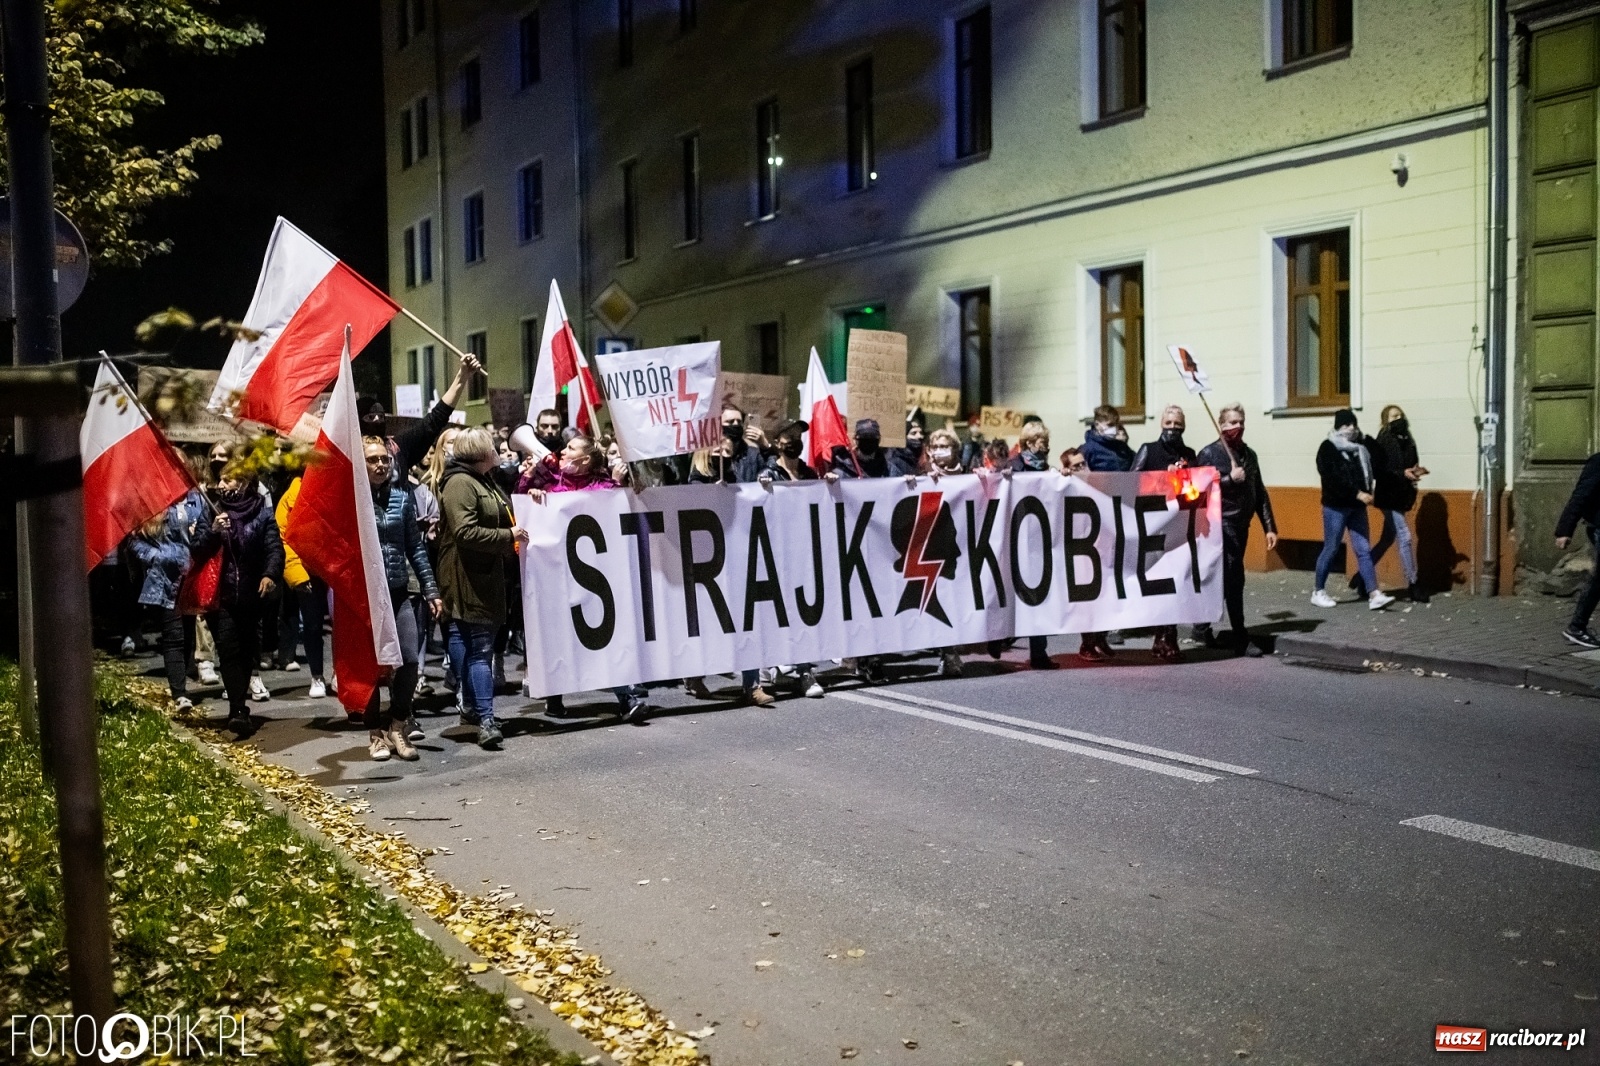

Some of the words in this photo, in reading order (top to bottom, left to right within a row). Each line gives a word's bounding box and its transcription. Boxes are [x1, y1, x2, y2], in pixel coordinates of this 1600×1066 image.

[600, 362, 674, 401] WYBÓR
[647, 396, 678, 426] NIE
[672, 416, 722, 451] ZAKA
[565, 501, 883, 651] STRAJK
[968, 493, 1207, 611] KOBIET
